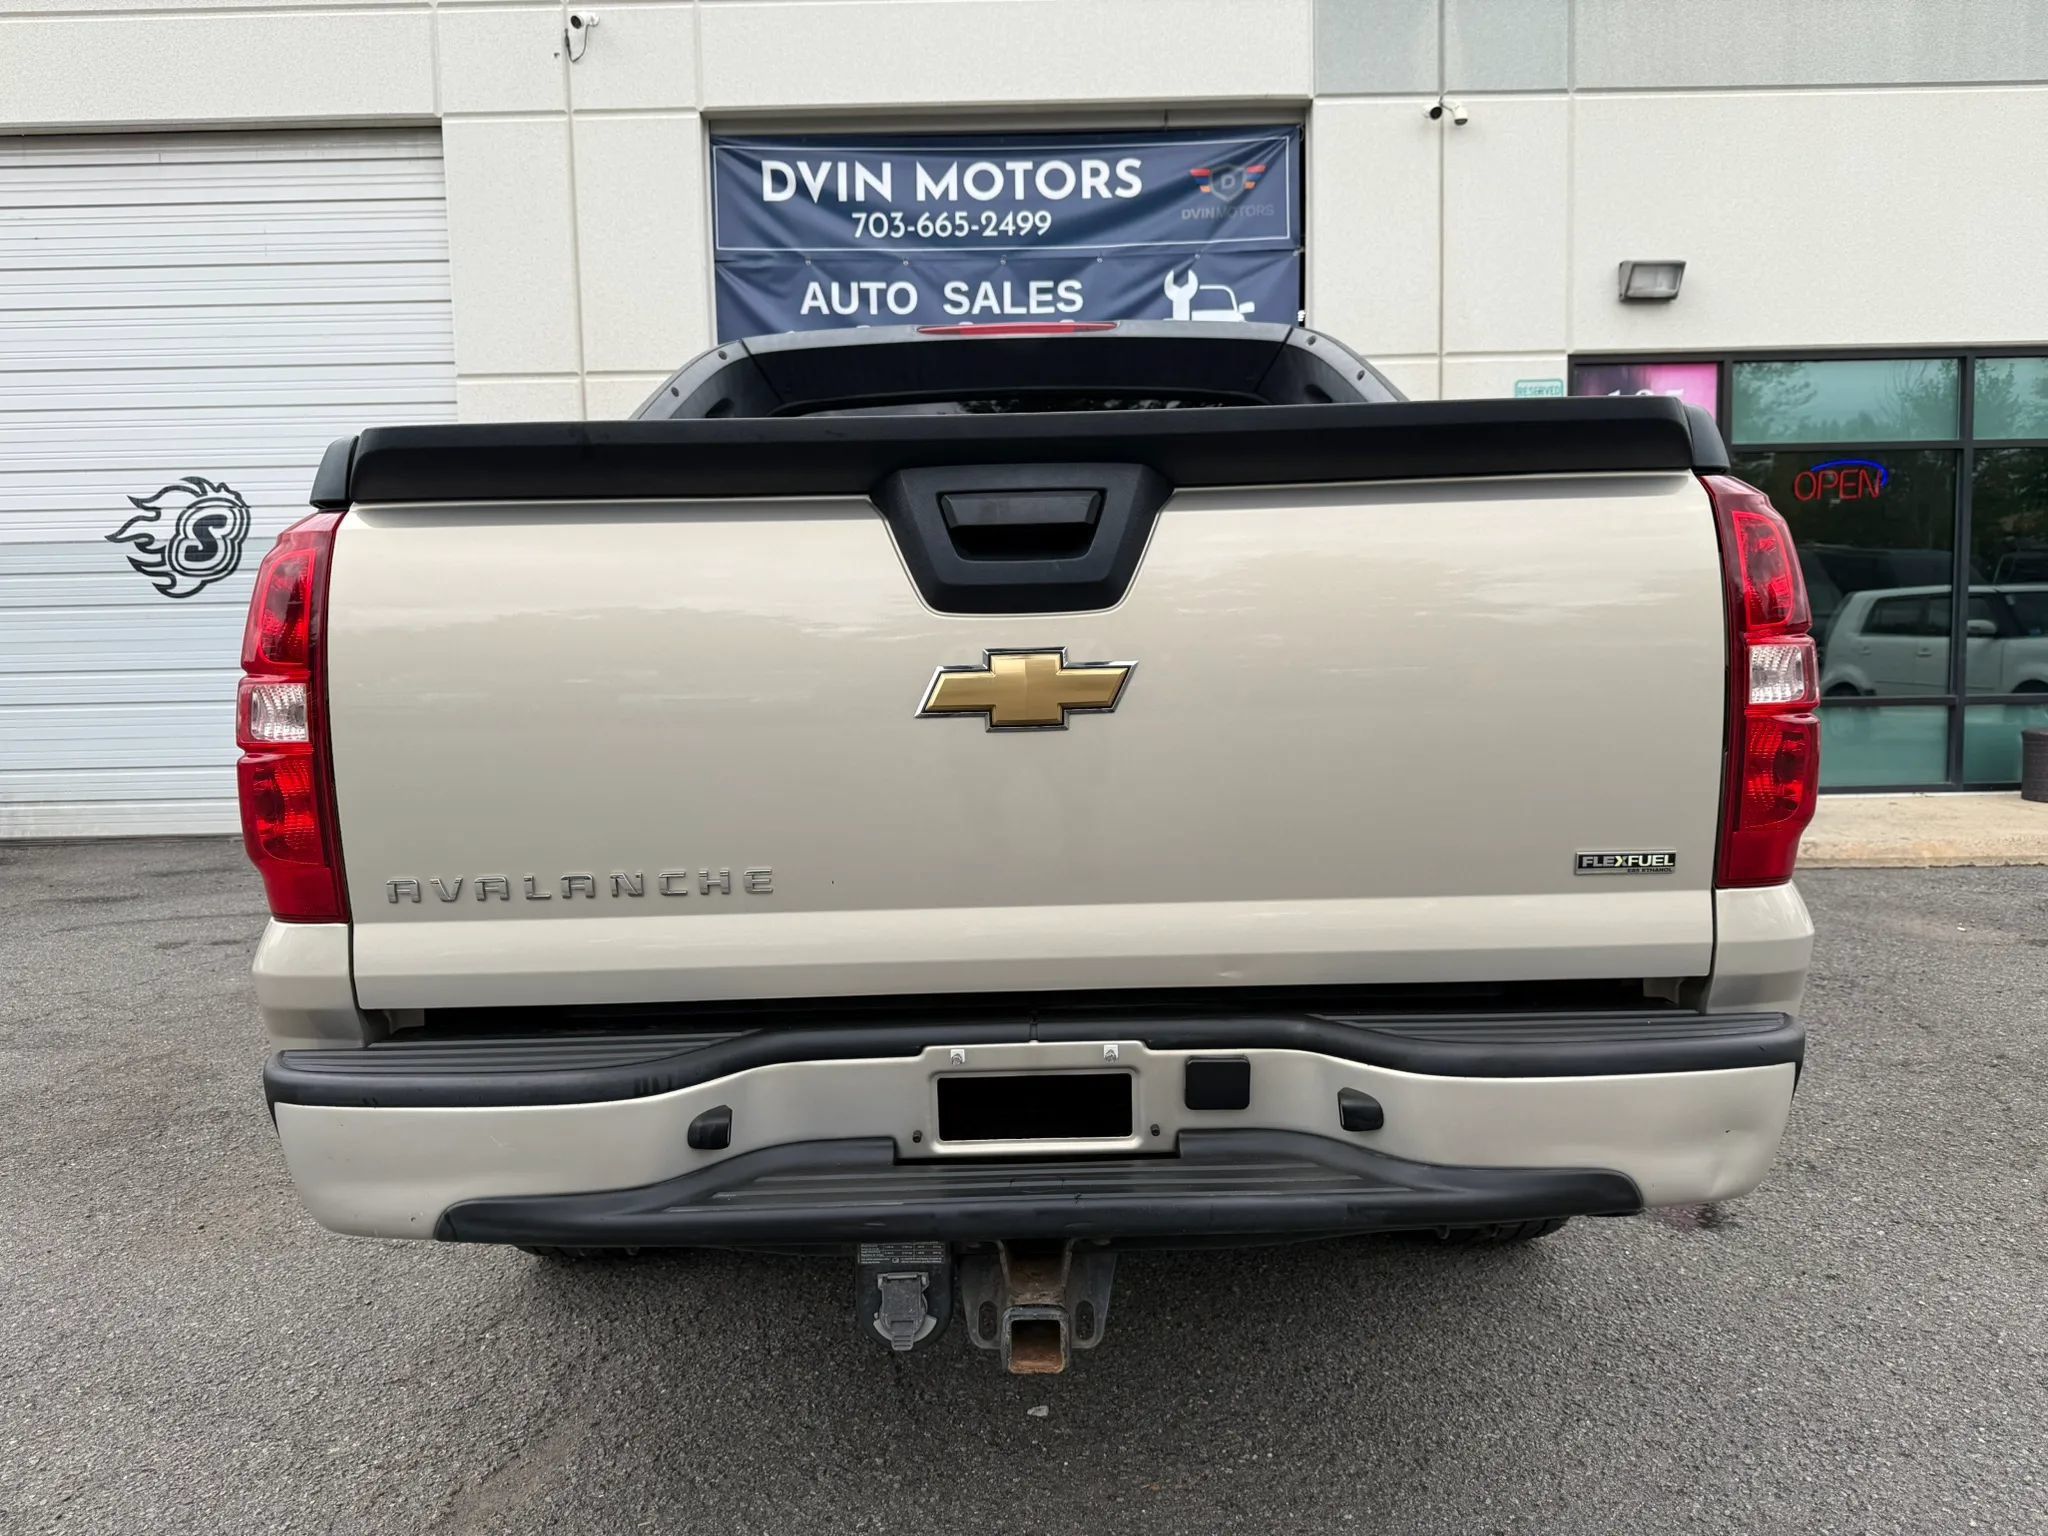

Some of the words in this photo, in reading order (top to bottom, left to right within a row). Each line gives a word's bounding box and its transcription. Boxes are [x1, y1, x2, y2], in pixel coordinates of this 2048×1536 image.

[761, 160, 894, 203] DVIN
[915, 158, 1143, 201] MOTORS
[851, 210, 1053, 239] 703-665-2499
[799, 280, 919, 316] AUTO
[942, 279, 1084, 315] SALES
[1517, 385, 1561, 396] RESERVED
[1793, 467, 1883, 502] OPEN
[1581, 854, 1674, 868] FLEXFUEL
[385, 867, 774, 904] AVALANCHE
